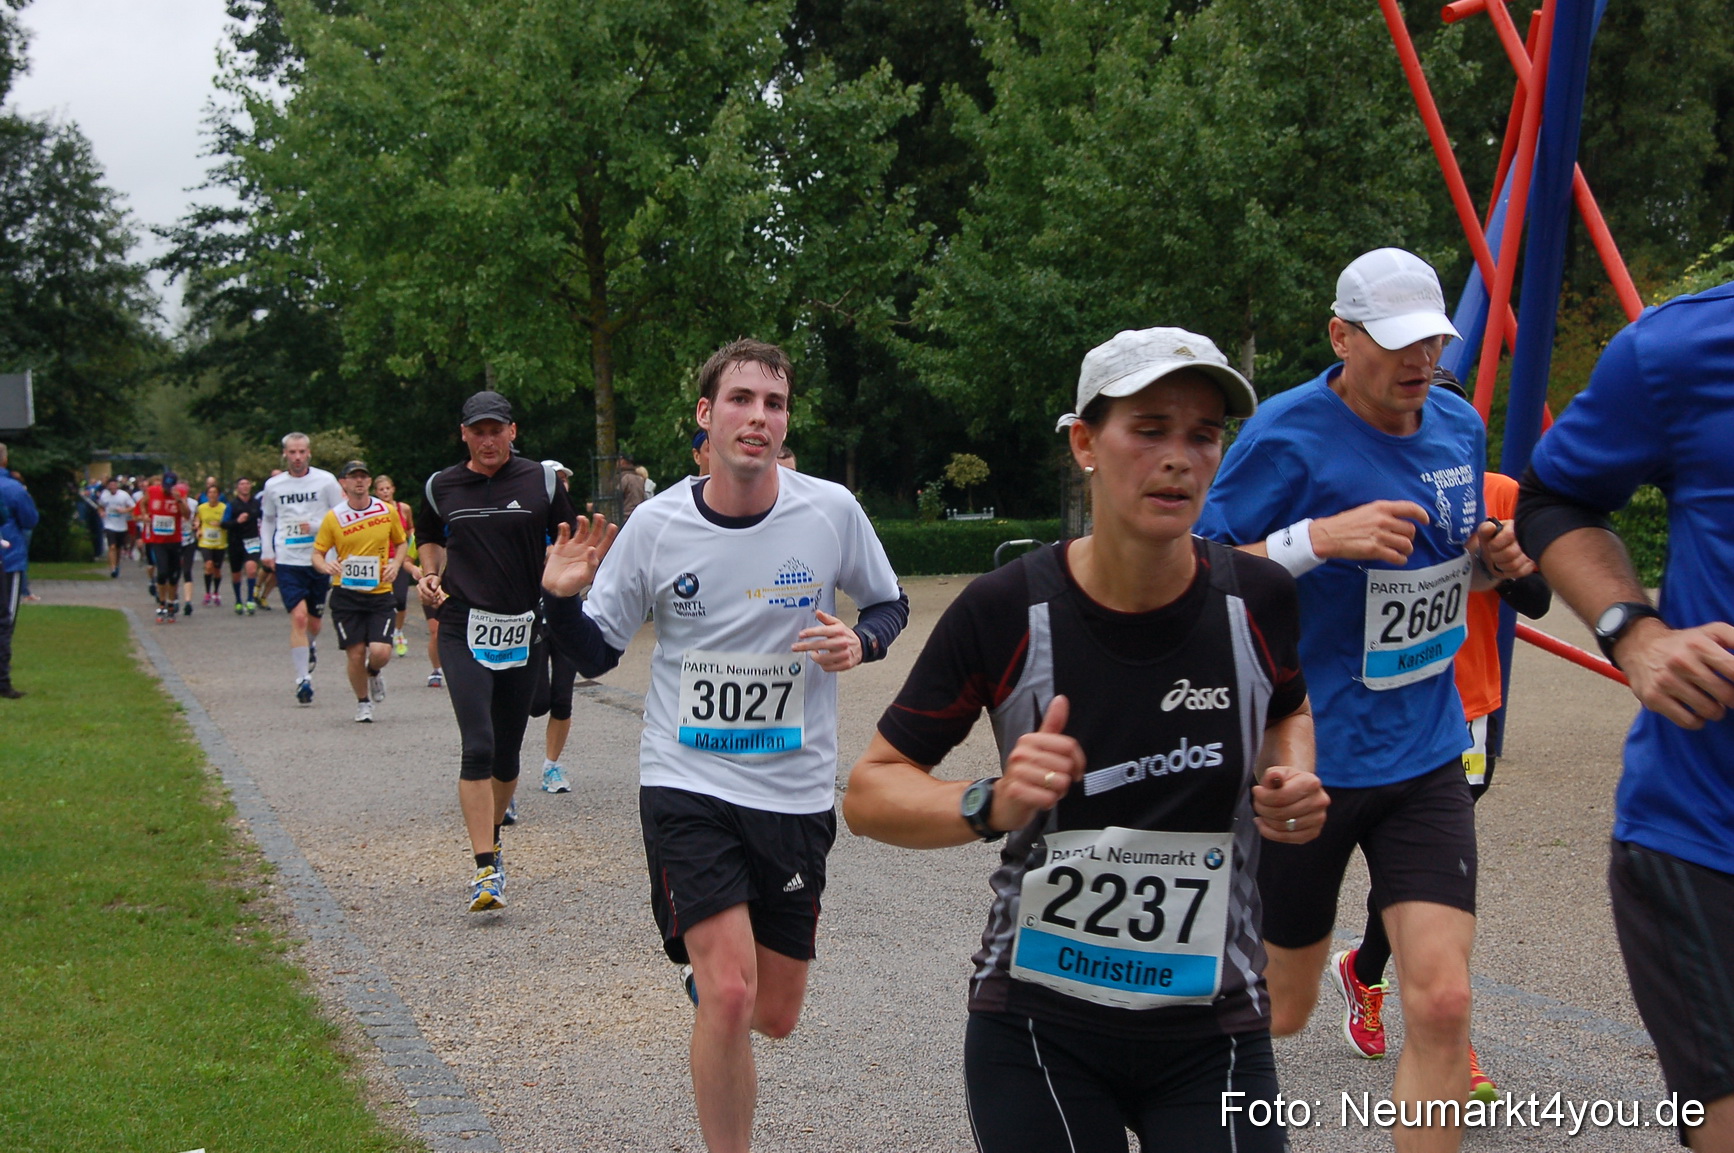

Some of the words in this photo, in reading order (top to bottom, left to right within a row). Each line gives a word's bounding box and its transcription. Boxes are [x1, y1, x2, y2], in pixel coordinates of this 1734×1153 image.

[280, 491, 318, 505] THULE
[343, 525, 364, 537] MAX
[345, 564, 375, 577] 3041
[1370, 582, 1415, 594] PARTL
[1418, 569, 1461, 592] Neumarkt
[746, 588, 767, 600] 14.
[673, 599, 706, 611] PARTL
[677, 609, 707, 618] umarkt
[1380, 582, 1462, 644] 2660
[471, 614, 493, 623] PARTL
[474, 624, 526, 647] 2049
[1397, 643, 1443, 671] Karsten
[683, 661, 723, 674] PARTL
[726, 664, 784, 677] Neumarkt
[691, 680, 793, 723] 3027
[695, 732, 785, 750] Maximilian
[1123, 737, 1224, 784] arados
[1107, 846, 1196, 867] Neumarkt
[1041, 865, 1210, 944] 2237
[1057, 946, 1174, 988] Christine
